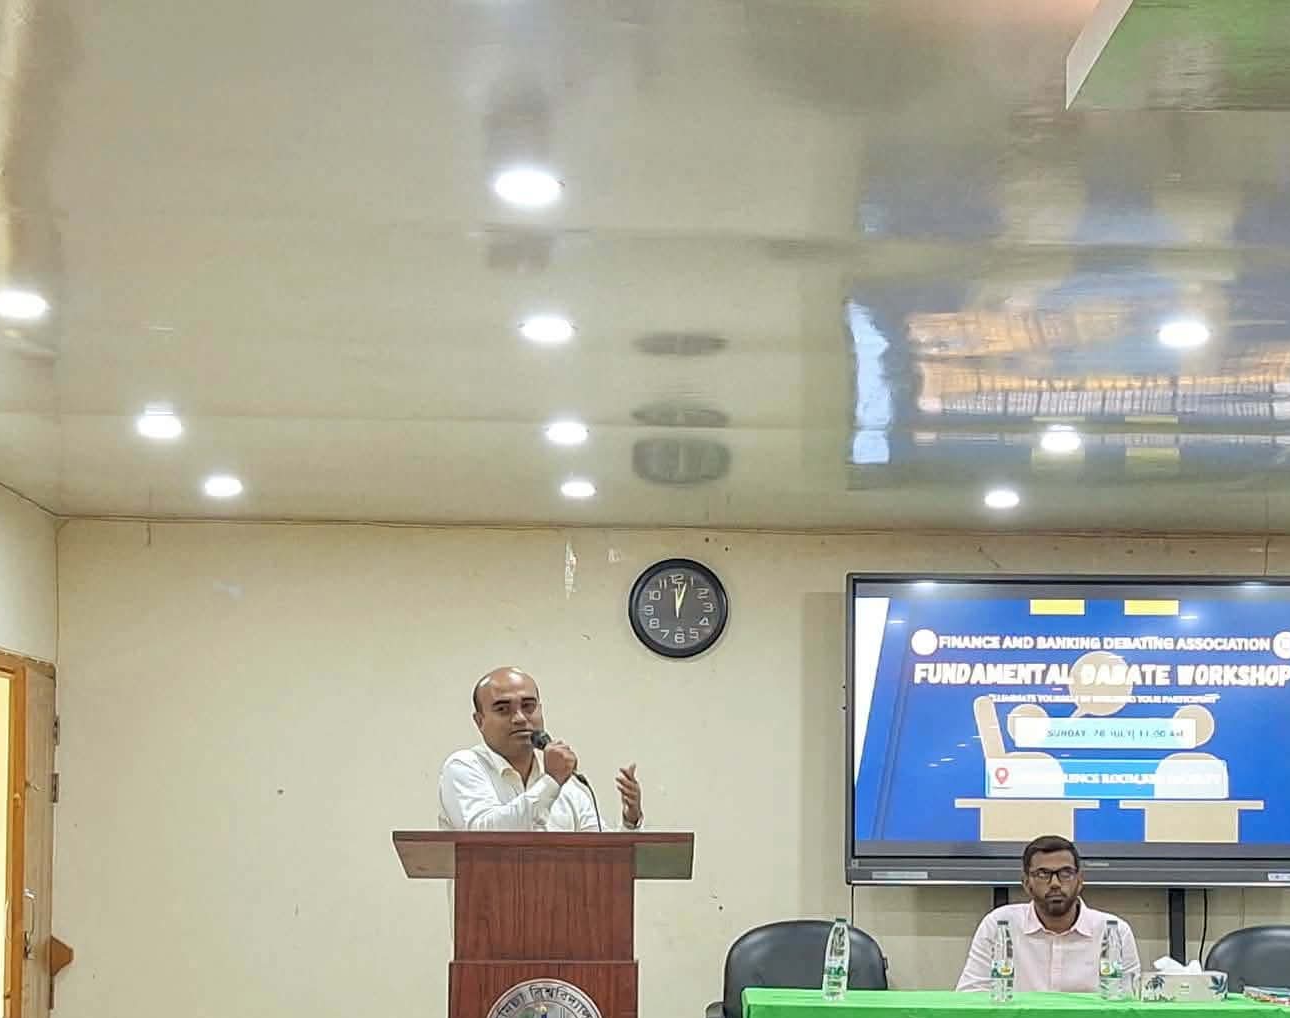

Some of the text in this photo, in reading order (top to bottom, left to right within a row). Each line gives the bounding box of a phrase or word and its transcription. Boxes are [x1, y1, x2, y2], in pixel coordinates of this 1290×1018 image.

[659, 578, 667, 589] 11
[669, 574, 685, 585] 12
[649, 590, 661, 601] 10
[697, 588, 709, 599] 2
[644, 605, 654, 616] 9
[703, 602, 714, 613] 3
[649, 618, 660, 629] 8
[699, 617, 710, 626] 4
[660, 629, 670, 640] 7
[674, 633, 685, 644] 6
[689, 628, 699, 640] 5
[938, 635, 1270, 651] FINANCE AND BANKING DEBATING ASSOCIATION
[914, 662, 1073, 685] FUNDAMENTAL
